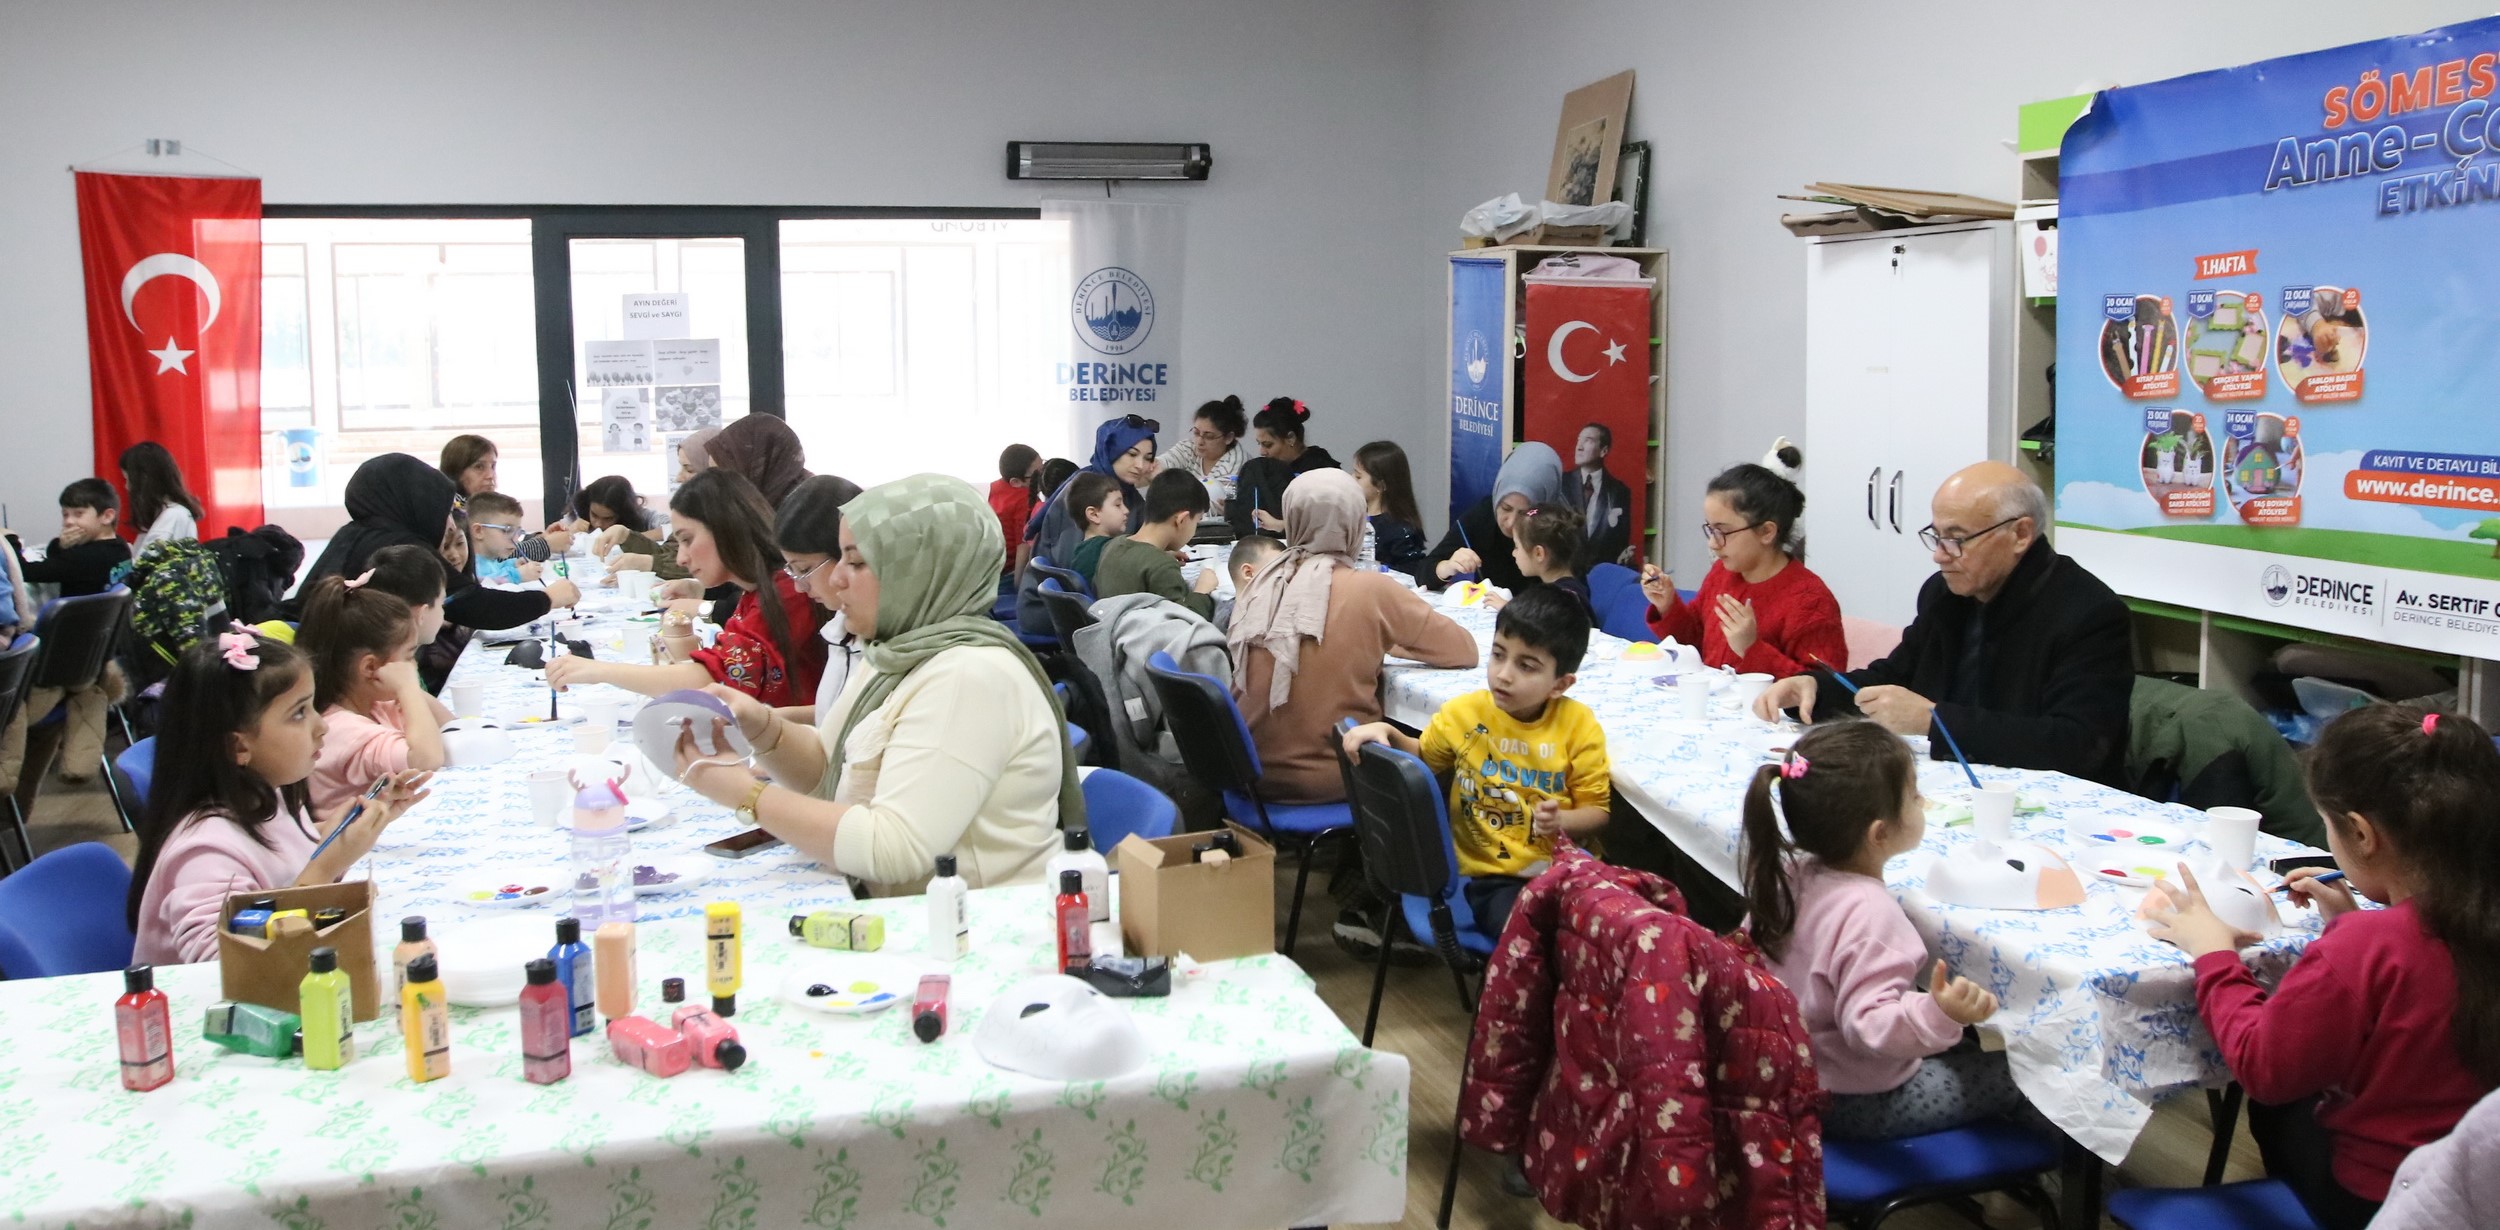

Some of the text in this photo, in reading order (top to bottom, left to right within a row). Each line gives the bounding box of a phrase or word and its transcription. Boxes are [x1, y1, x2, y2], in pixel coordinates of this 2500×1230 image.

[2323, 52, 2500, 130] SÖMES
[2202, 255, 2247, 276] 1.HAFTA
[2189, 294, 2214, 304] 21 OCAK
[2284, 290, 2311, 300] 22 OCAK
[2346, 291, 2356, 299] 20
[2106, 297, 2134, 307] 20 OCAK
[2154, 410, 2169, 420] OCAK
[2227, 413, 2254, 424] 24 OCAK
[2373, 455, 2405, 468] KAYIT
[2408, 457, 2424, 470] VE
[2427, 458, 2478, 473] DETAYLI
[2396, 590, 2422, 607] Av.
